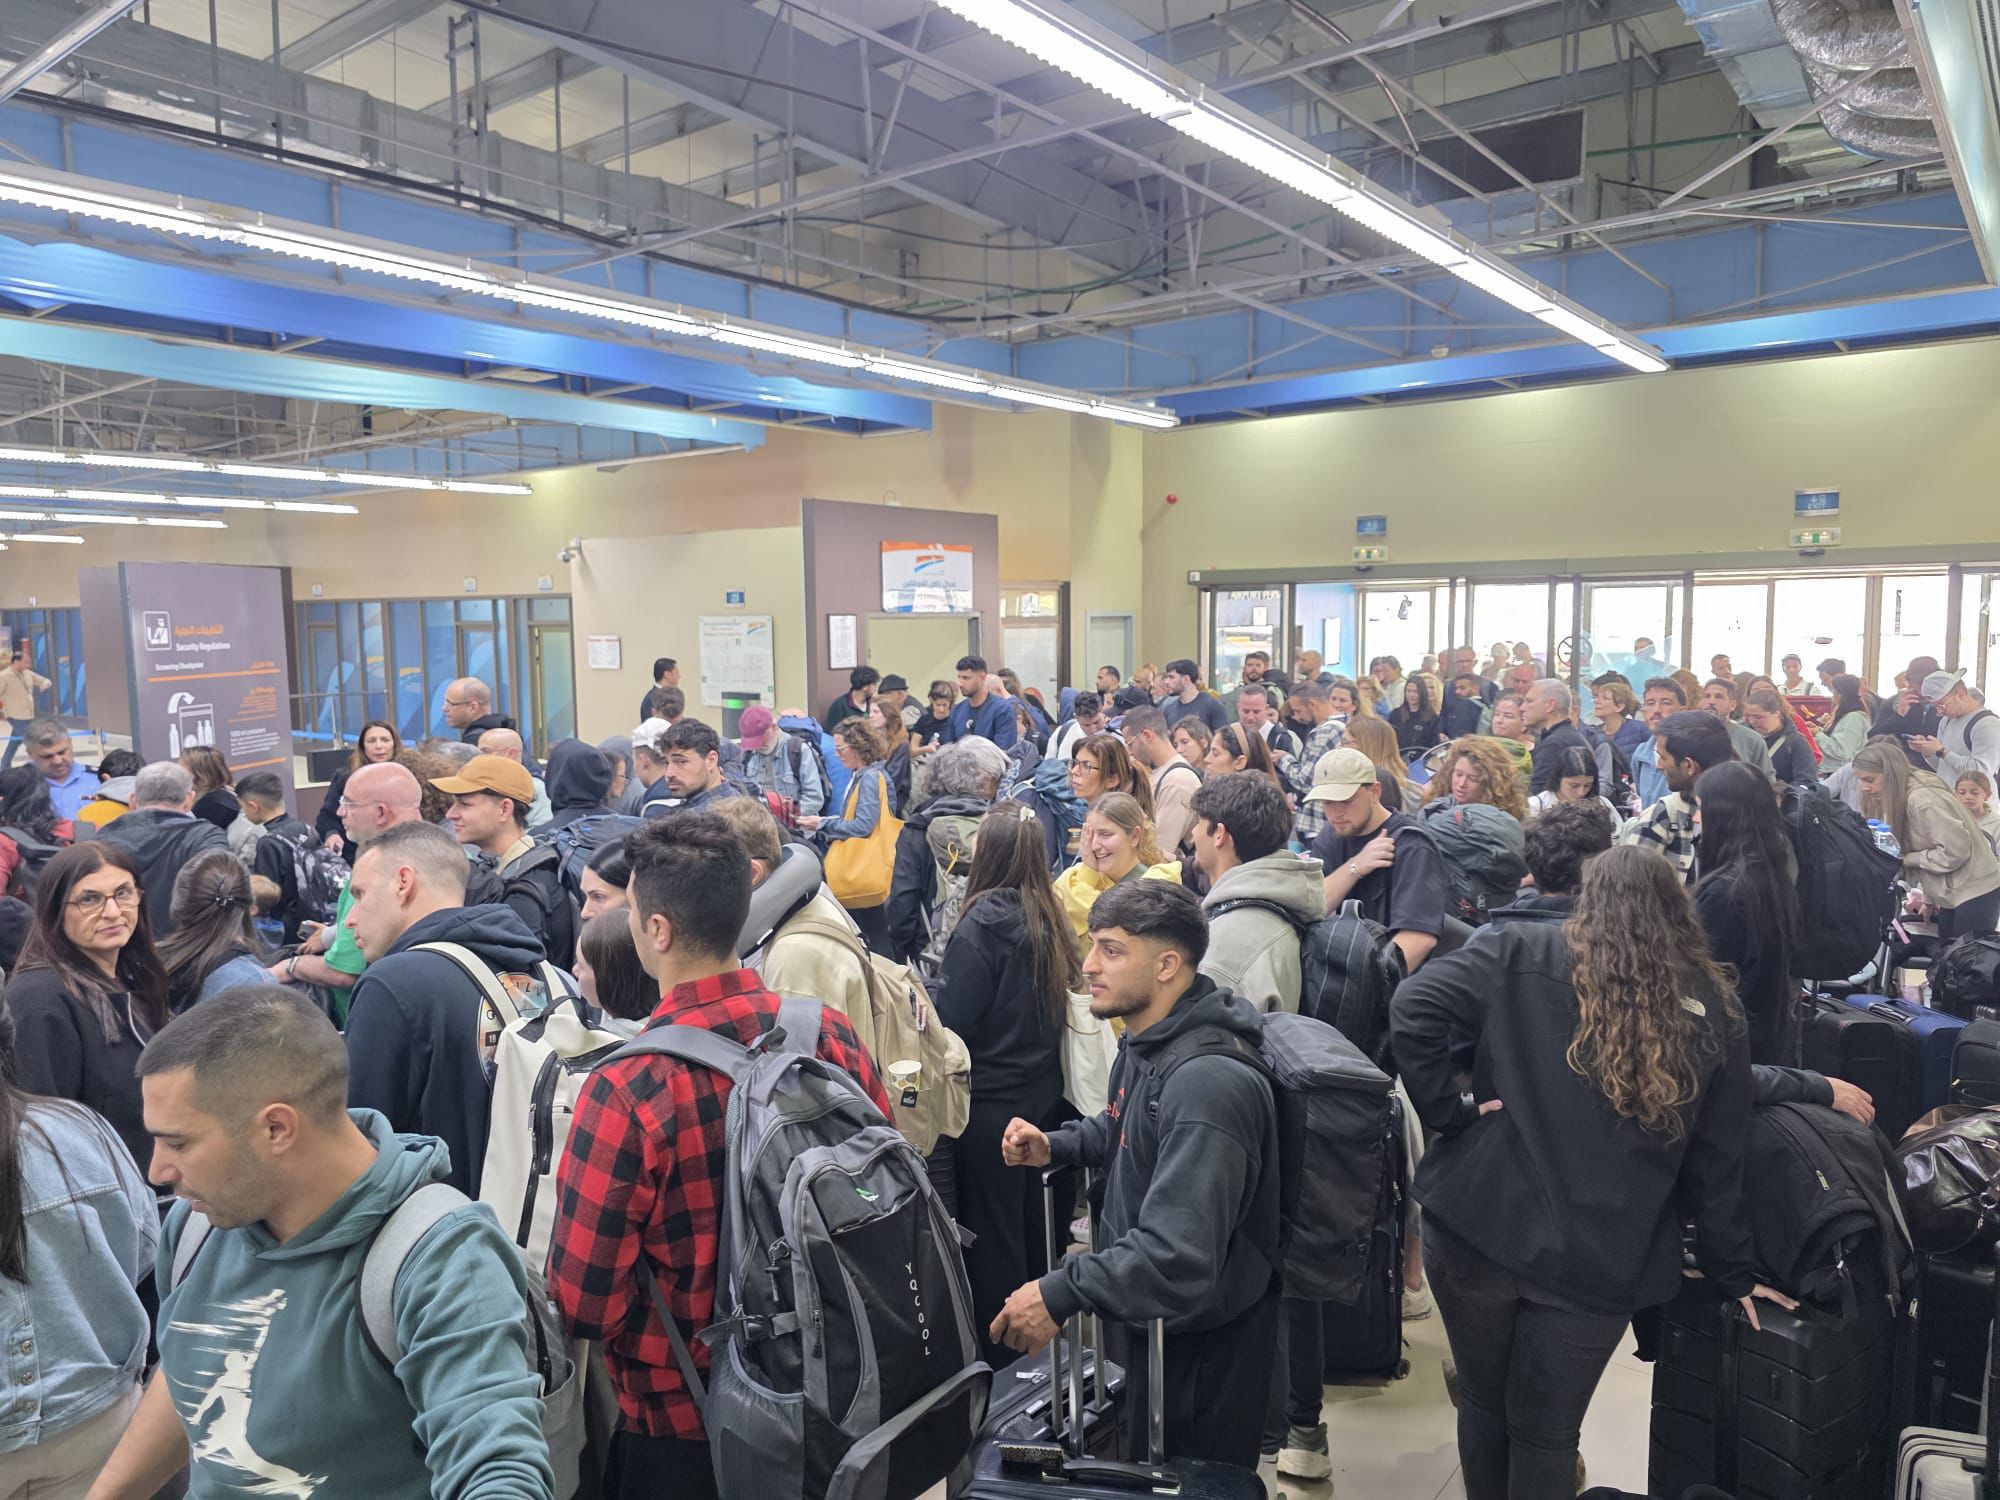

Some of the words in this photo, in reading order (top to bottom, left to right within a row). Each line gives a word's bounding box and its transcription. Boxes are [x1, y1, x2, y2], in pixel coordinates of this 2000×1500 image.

[176, 643, 199, 652] Security
[200, 642, 231, 652] Regulations
[905, 1262, 931, 1356] YQCOOL
